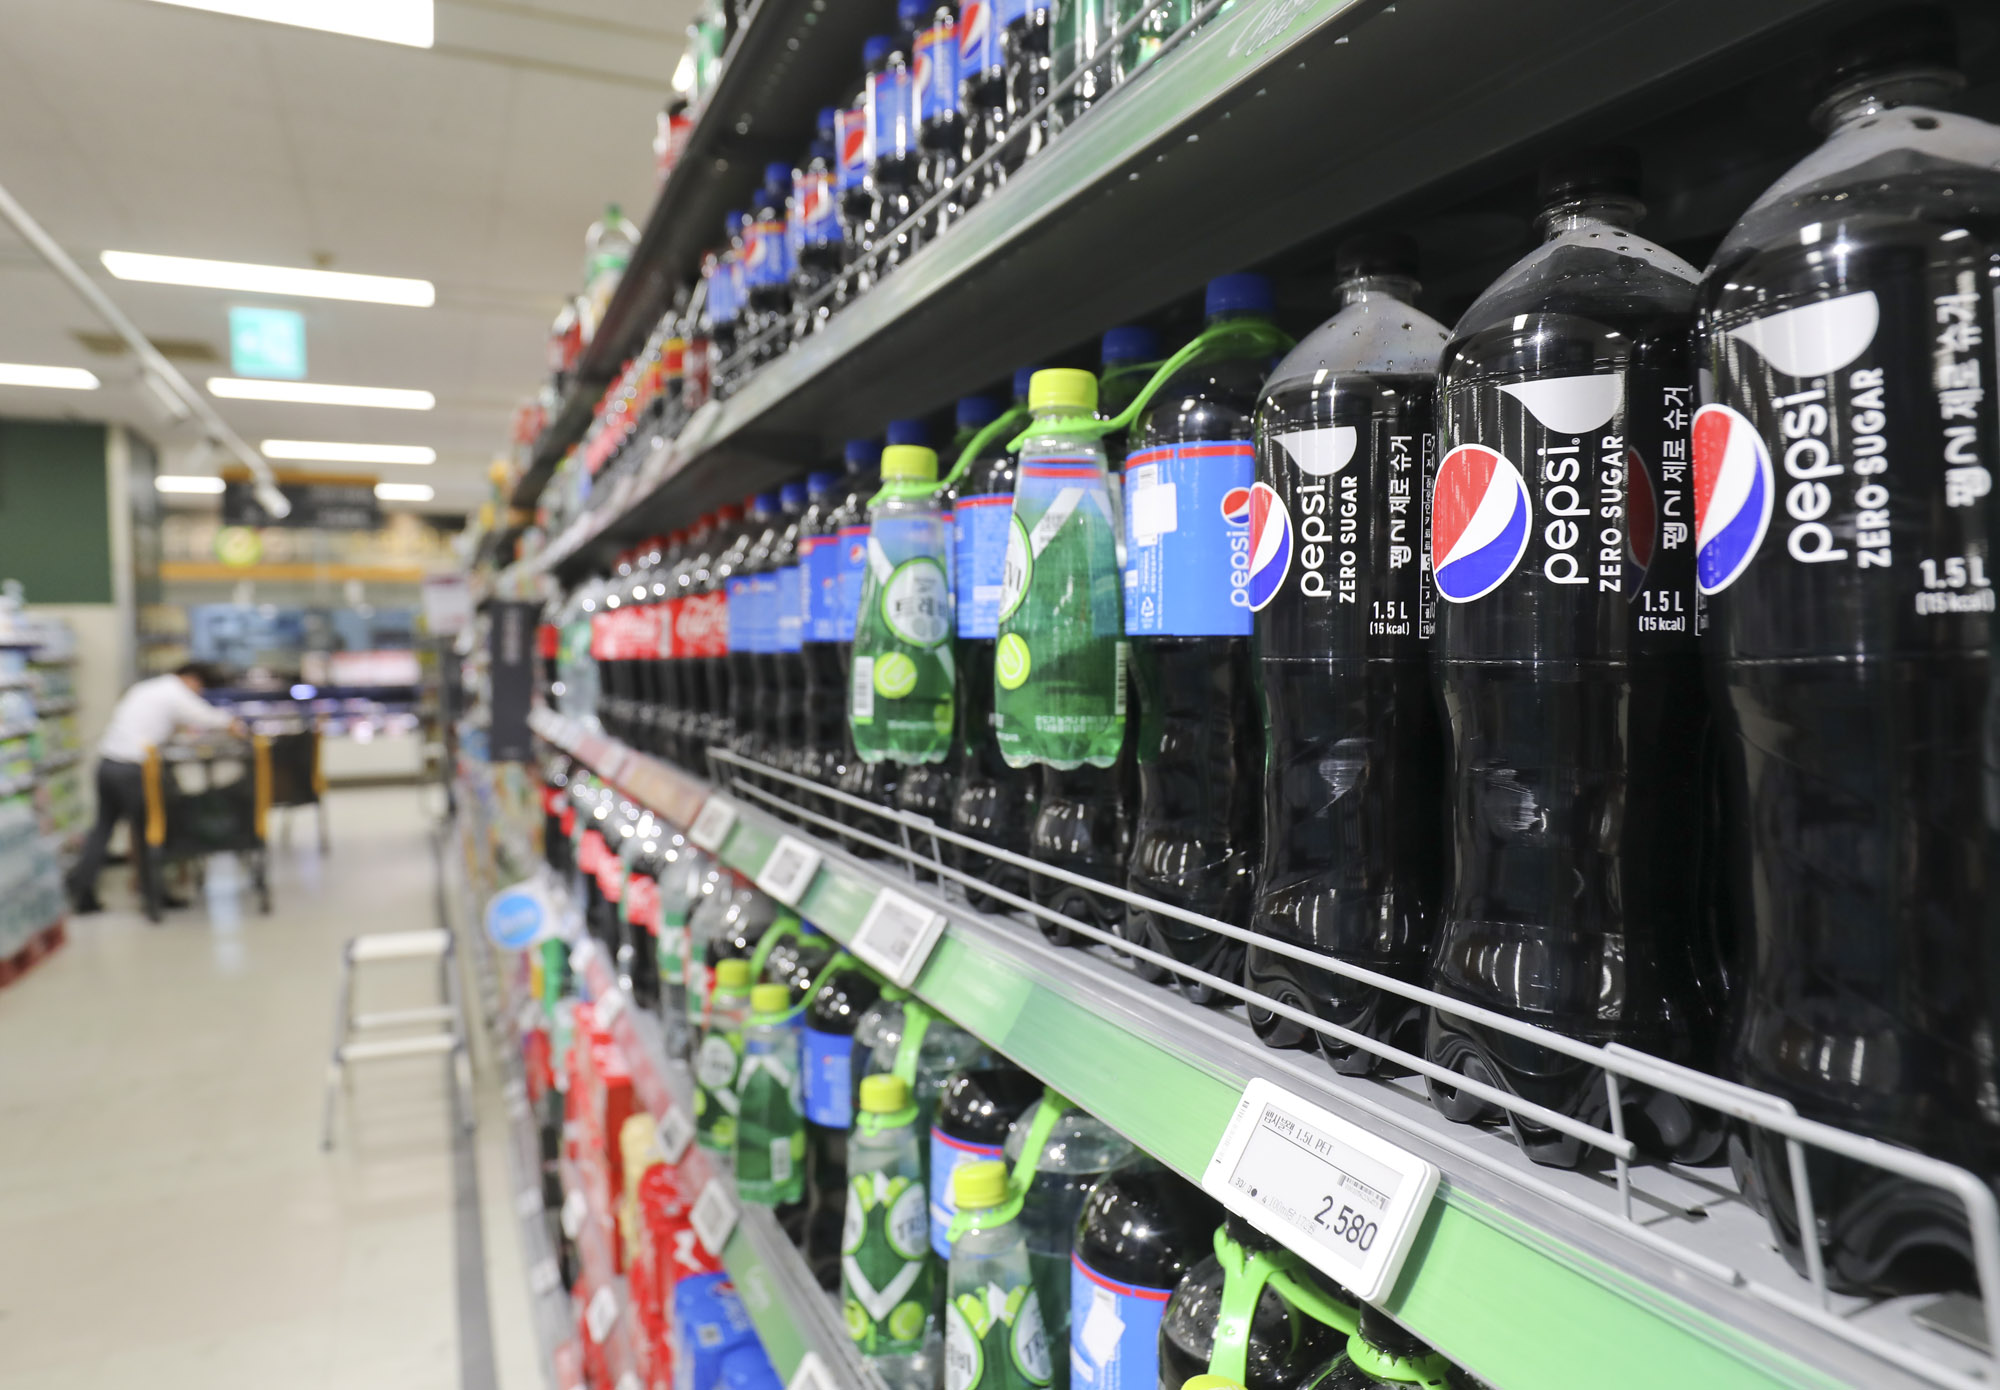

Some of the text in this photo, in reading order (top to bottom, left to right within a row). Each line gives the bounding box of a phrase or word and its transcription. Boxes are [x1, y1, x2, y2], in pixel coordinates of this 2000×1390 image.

[1934, 294, 1982, 352] 슈거
[1937, 358, 1984, 420] 제로
[1389, 436, 1412, 568] 펩시 제로 슈거
[1662, 386, 1690, 550] 펩시 제로 슈거
[1771, 389, 1848, 563] pepsi
[1851, 368, 1892, 568] ZERO SUGAR
[1296, 485, 1332, 597] pepsi
[1339, 476, 1358, 603] ZERO SUGAR
[1537, 446, 1591, 584] pepsi
[1599, 435, 1624, 592] ZERO SUGAR
[1226, 531, 1250, 607] pepsi
[1642, 591, 1670, 612] 1.5
[1370, 622, 1410, 635] (15 kcal)
[1373, 601, 1395, 619] 1.5
[1638, 615, 1685, 632] (15 kcal)
[1296, 1128, 1314, 1147] 1.5L
[1314, 1138, 1334, 1156] PET
[1313, 1195, 1378, 1252] 2,580
